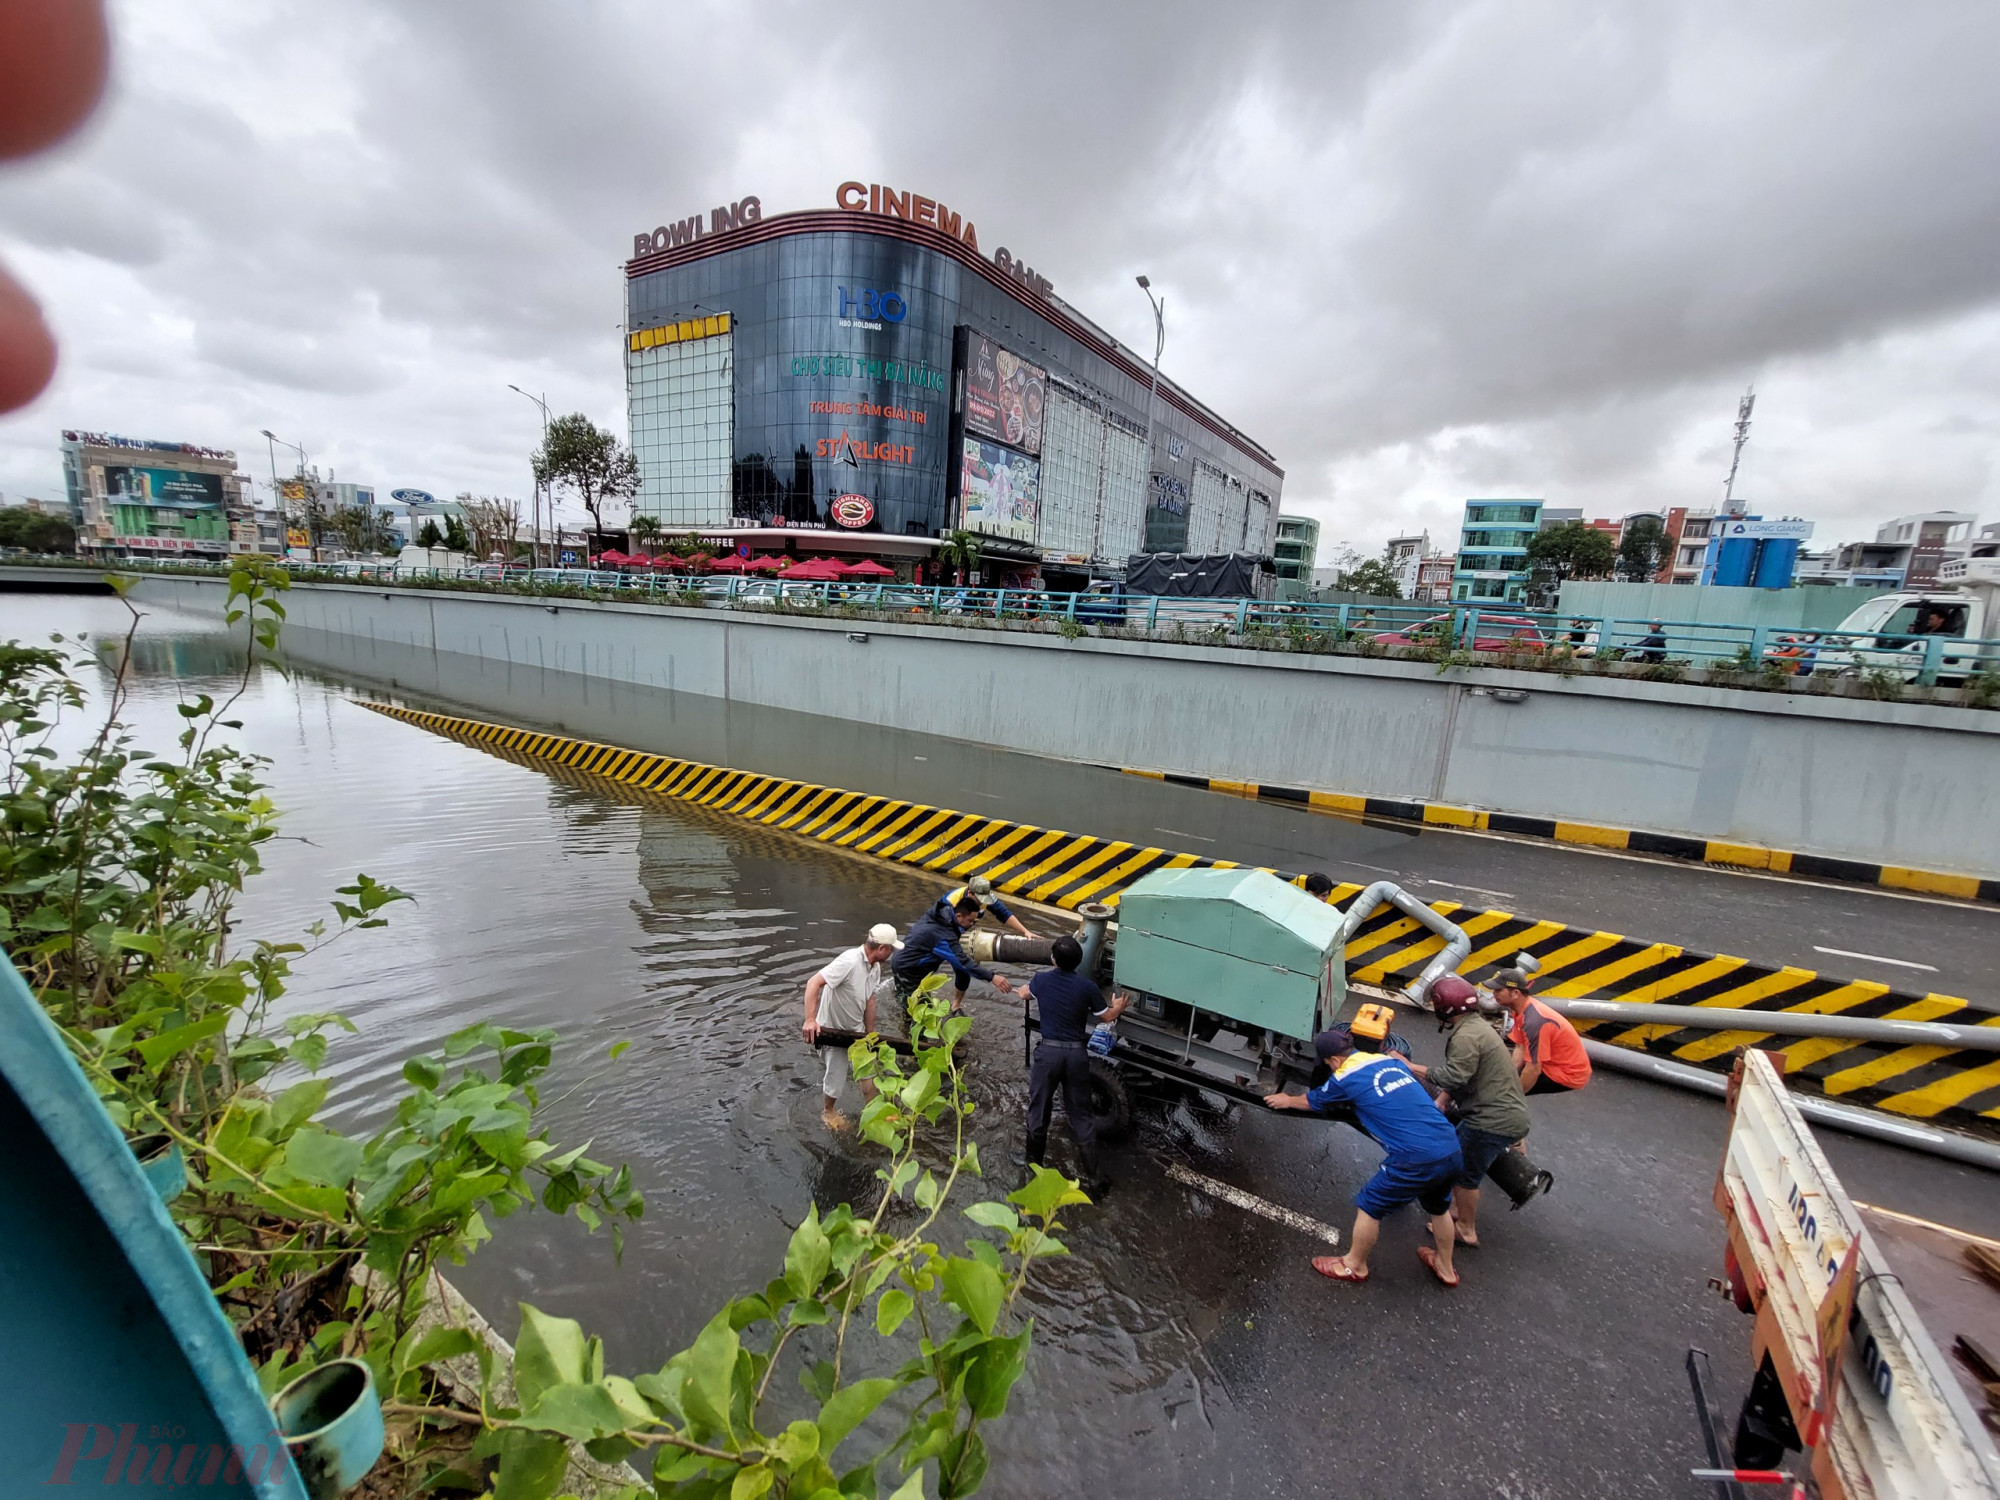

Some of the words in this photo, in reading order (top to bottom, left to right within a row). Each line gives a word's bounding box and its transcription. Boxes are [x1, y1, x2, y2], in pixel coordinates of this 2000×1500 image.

[836, 181, 978, 251] CINEMA
[634, 195, 761, 259] BOWLING
[994, 246, 1053, 300] GAME
[838, 285, 906, 322] HBO
[839, 319, 852, 327] HBO
[853, 320, 882, 331] HOLDINGS
[791, 356, 819, 382] CHỢ
[822, 352, 853, 377] SIÊU
[857, 359, 882, 384] THỊ
[908, 359, 945, 392] NẴNG
[810, 401, 852, 415] TRUNG
[854, 401, 881, 417] TÂM
[403, 490, 426, 502] Ford
[833, 496, 872, 511] HIGHLANDS
[838, 516, 867, 526] COFFEE
[1777, 525, 1806, 533] GIANG
